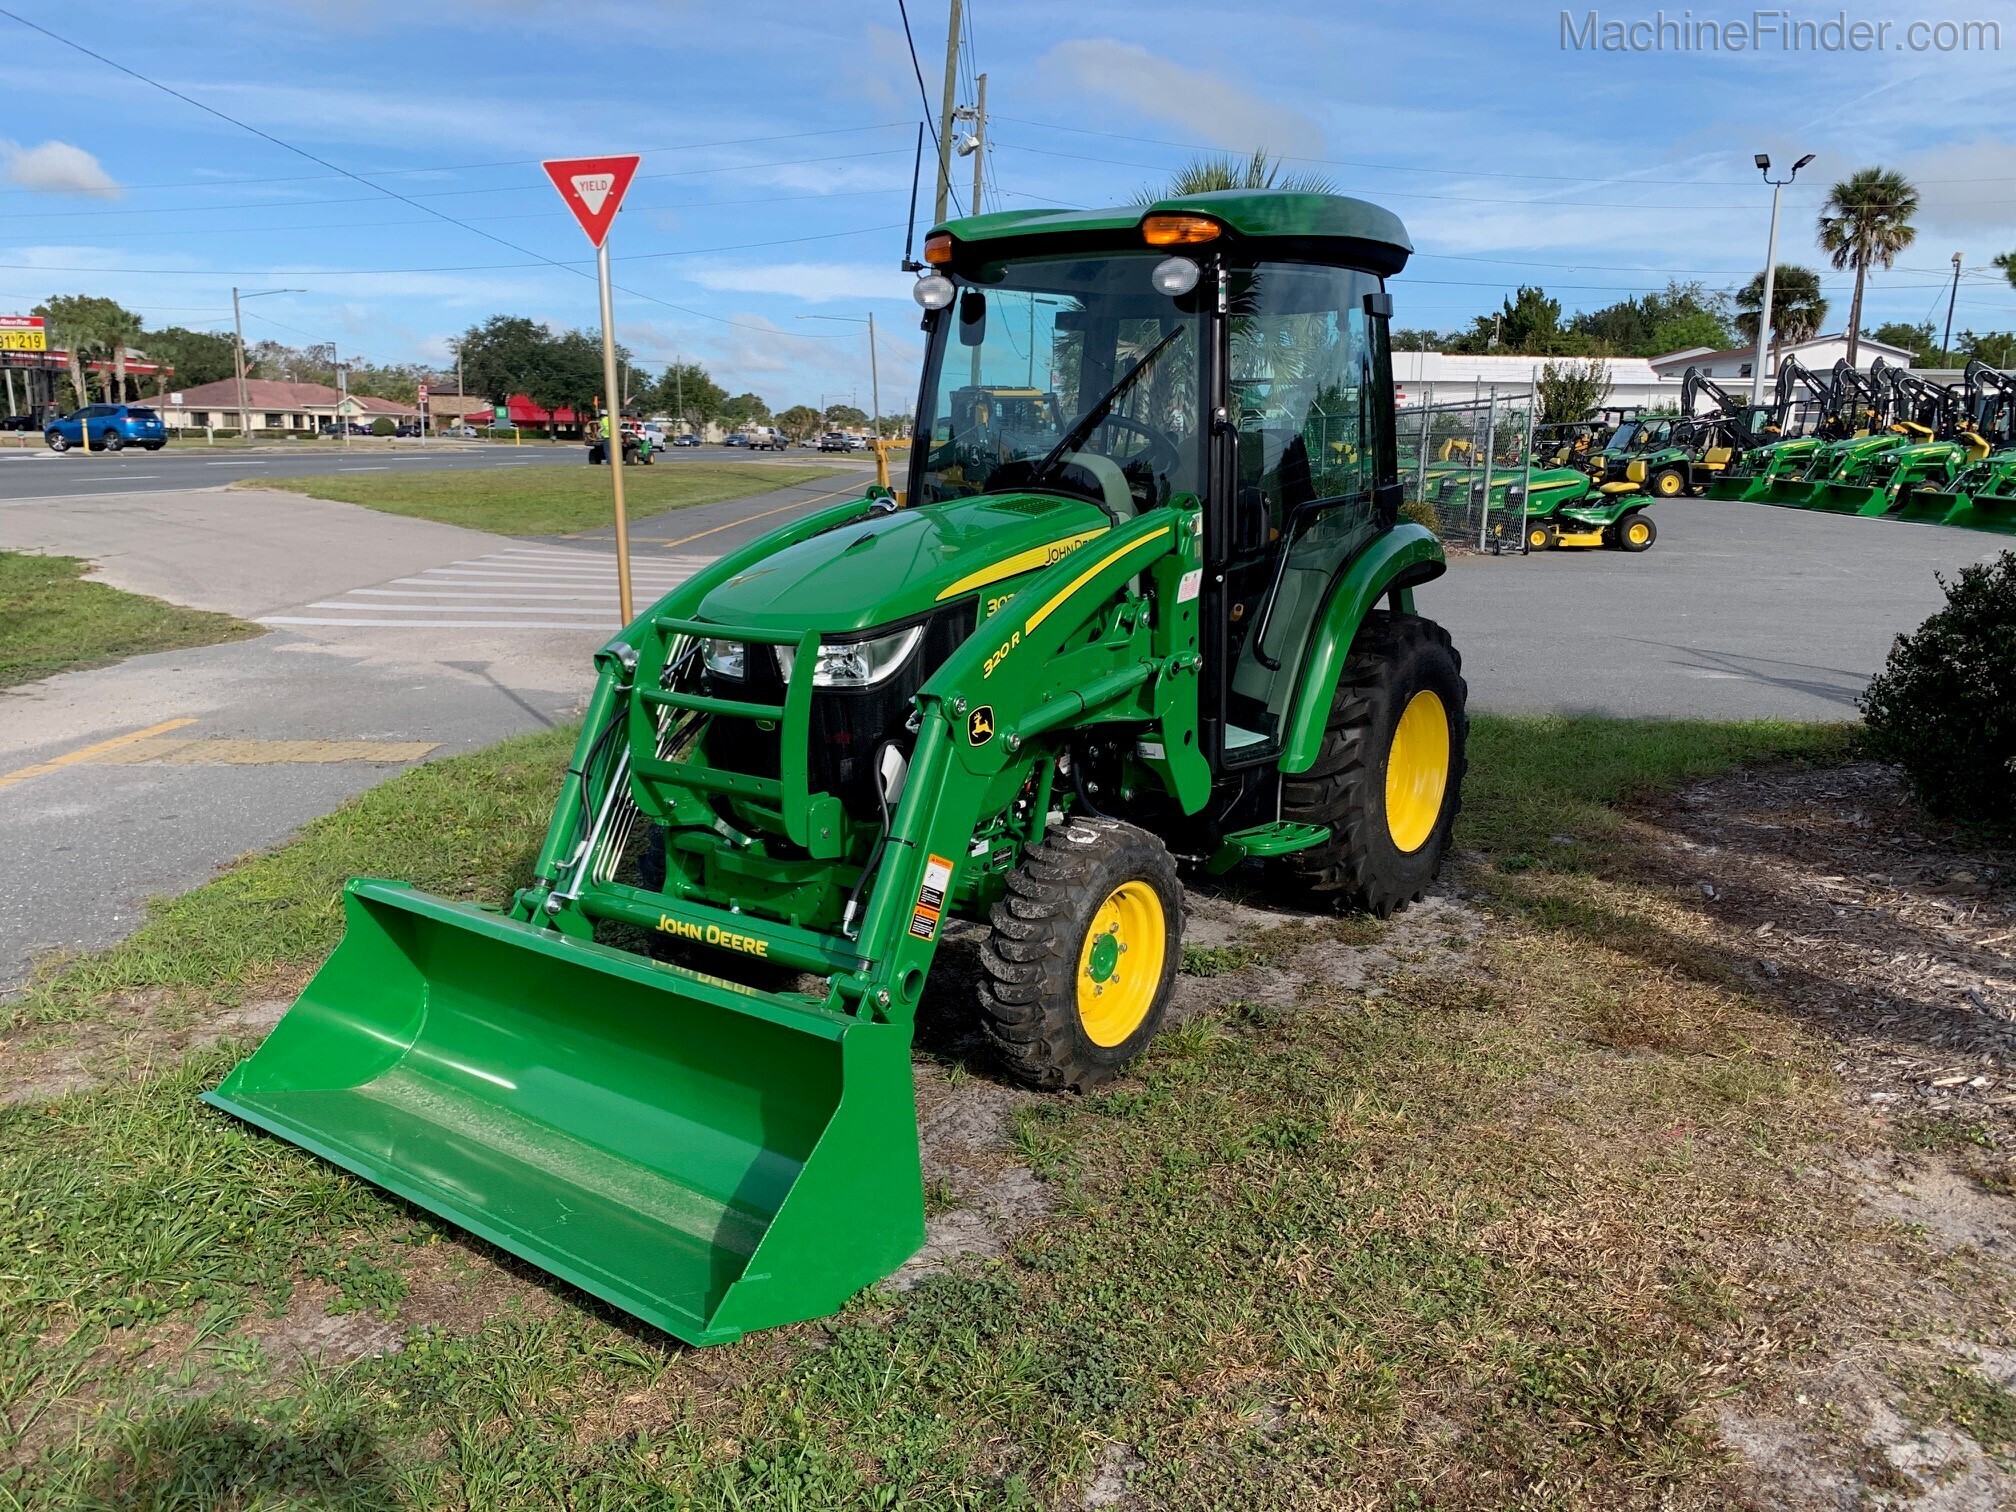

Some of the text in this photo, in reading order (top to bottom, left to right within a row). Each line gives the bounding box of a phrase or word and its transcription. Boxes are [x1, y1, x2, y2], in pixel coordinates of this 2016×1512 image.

[579, 181, 607, 191] YIELD
[987, 593, 1015, 617] 30
[983, 631, 1020, 680] 320 R
[655, 914, 769, 957] JOHN DEERE
